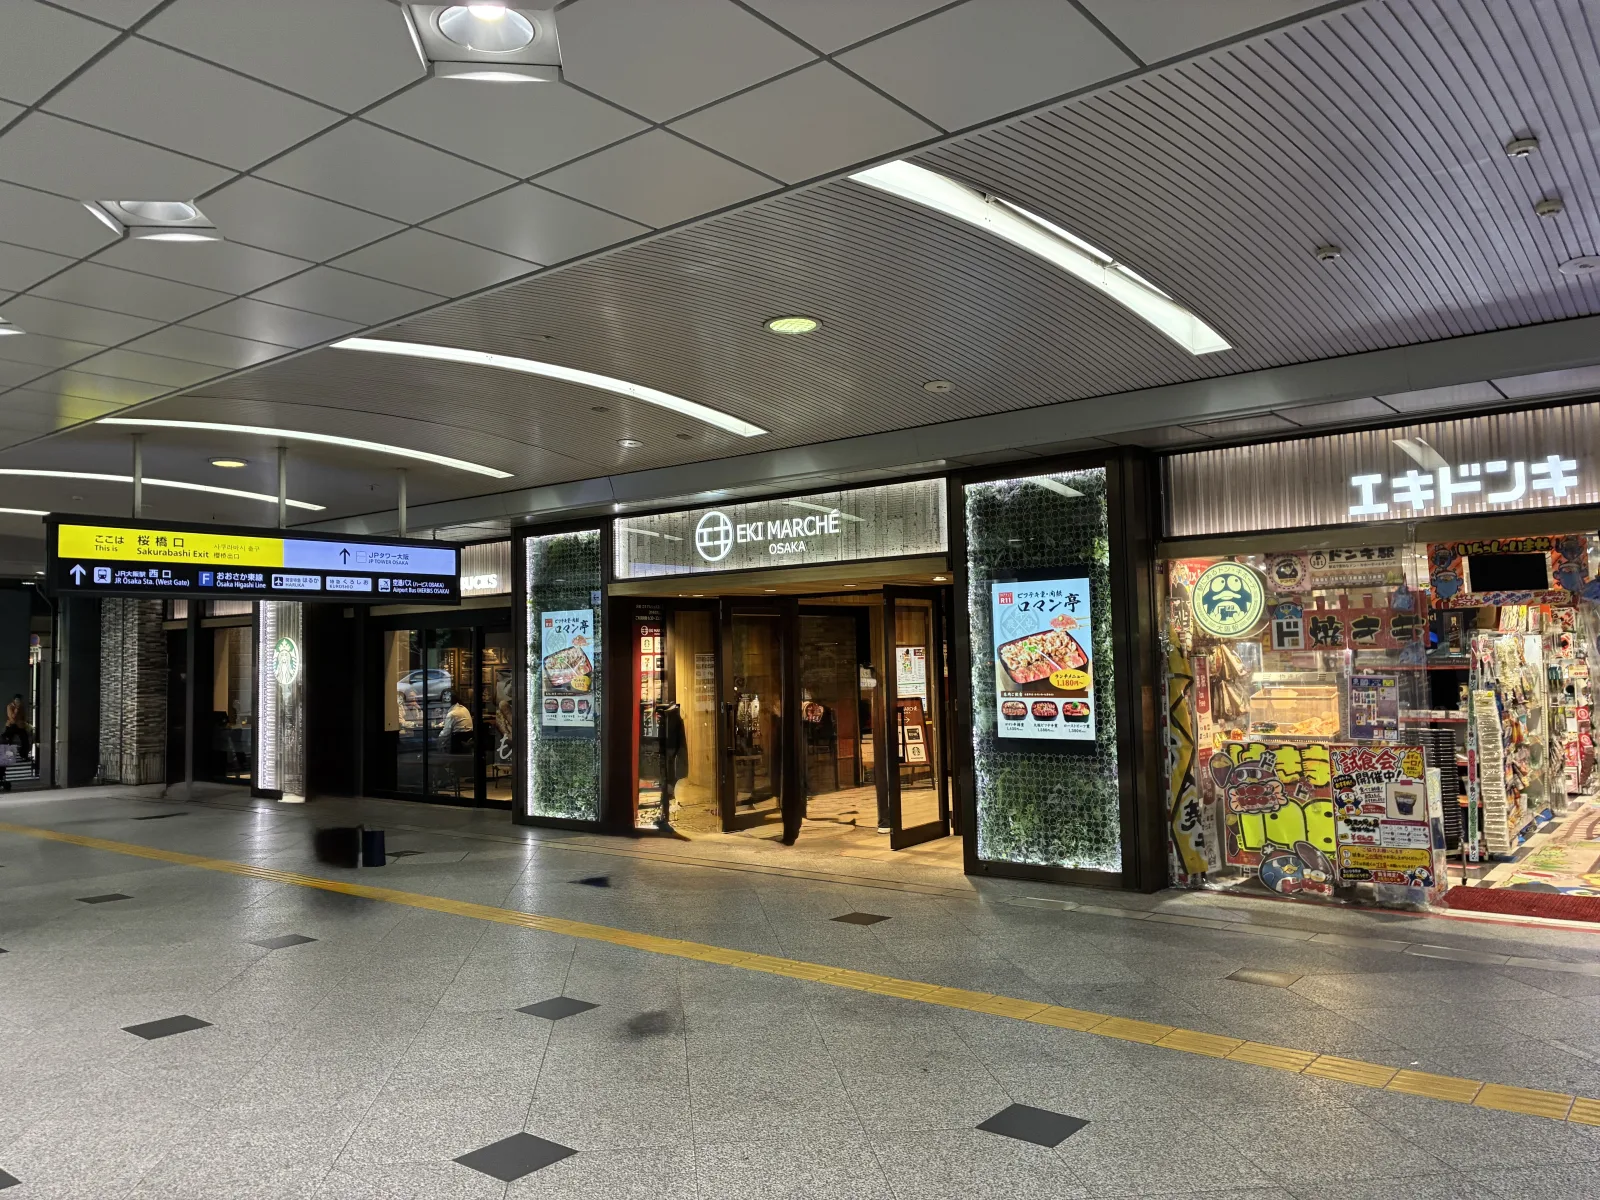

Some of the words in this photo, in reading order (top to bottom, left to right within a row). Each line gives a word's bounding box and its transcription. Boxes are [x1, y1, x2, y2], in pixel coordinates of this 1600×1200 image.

[1349, 454, 1578, 516] エキドンキ
[736, 522, 764, 543] EKI
[767, 508, 841, 540] MARCHÉ
[95, 534, 125, 545] ここは
[137, 535, 184, 548] 桜橋口
[769, 540, 806, 555] OSAKA
[1457, 537, 1553, 556] いらっしゃいませ
[95, 544, 110, 552] This
[137, 547, 191, 558] Sakurabashi
[193, 549, 209, 558] Exit
[368, 551, 410, 561] JPタワー大阪
[1329, 546, 1395, 562] ドンキ駅
[155, 578, 172, 587] (West
[173, 578, 190, 587] Gate)
[202, 573, 210, 584] F
[216, 571, 264, 582] おおさか東線
[302, 576, 319, 584] はるか
[343, 578, 369, 586] くろしお
[235, 580, 254, 589] Higashi
[1017, 593, 1082, 613] ロマン亭
[1217, 624, 1240, 633] 大阪駅
[1340, 749, 1398, 774] 試食会
[1355, 770, 1403, 785] 開催中!
